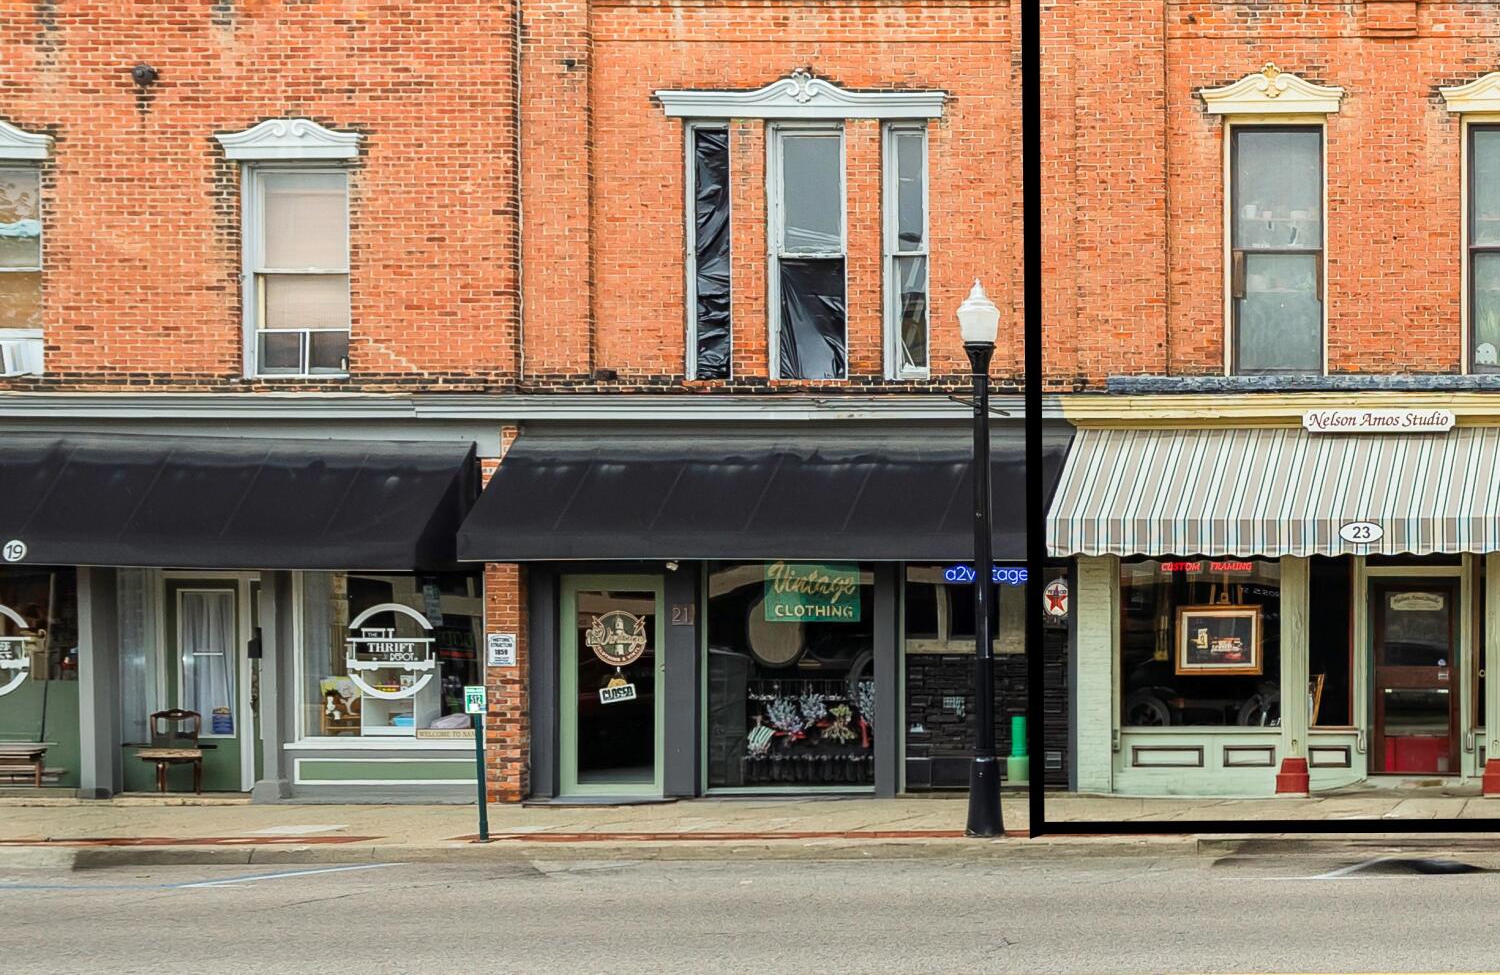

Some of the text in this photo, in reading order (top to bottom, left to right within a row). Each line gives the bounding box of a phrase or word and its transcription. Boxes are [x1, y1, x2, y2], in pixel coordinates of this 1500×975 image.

[1309, 411, 1449, 429] Nelson Amos Studio
[1352, 526, 1371, 539] 23
[5, 544, 24, 560] 19
[1161, 561, 1253, 572] CUSTOM FRAMING
[767, 561, 856, 604] Vintage
[671, 607, 689, 623] 21
[774, 604, 854, 618] CLOTHING
[366, 642, 415, 653] THRIFT
